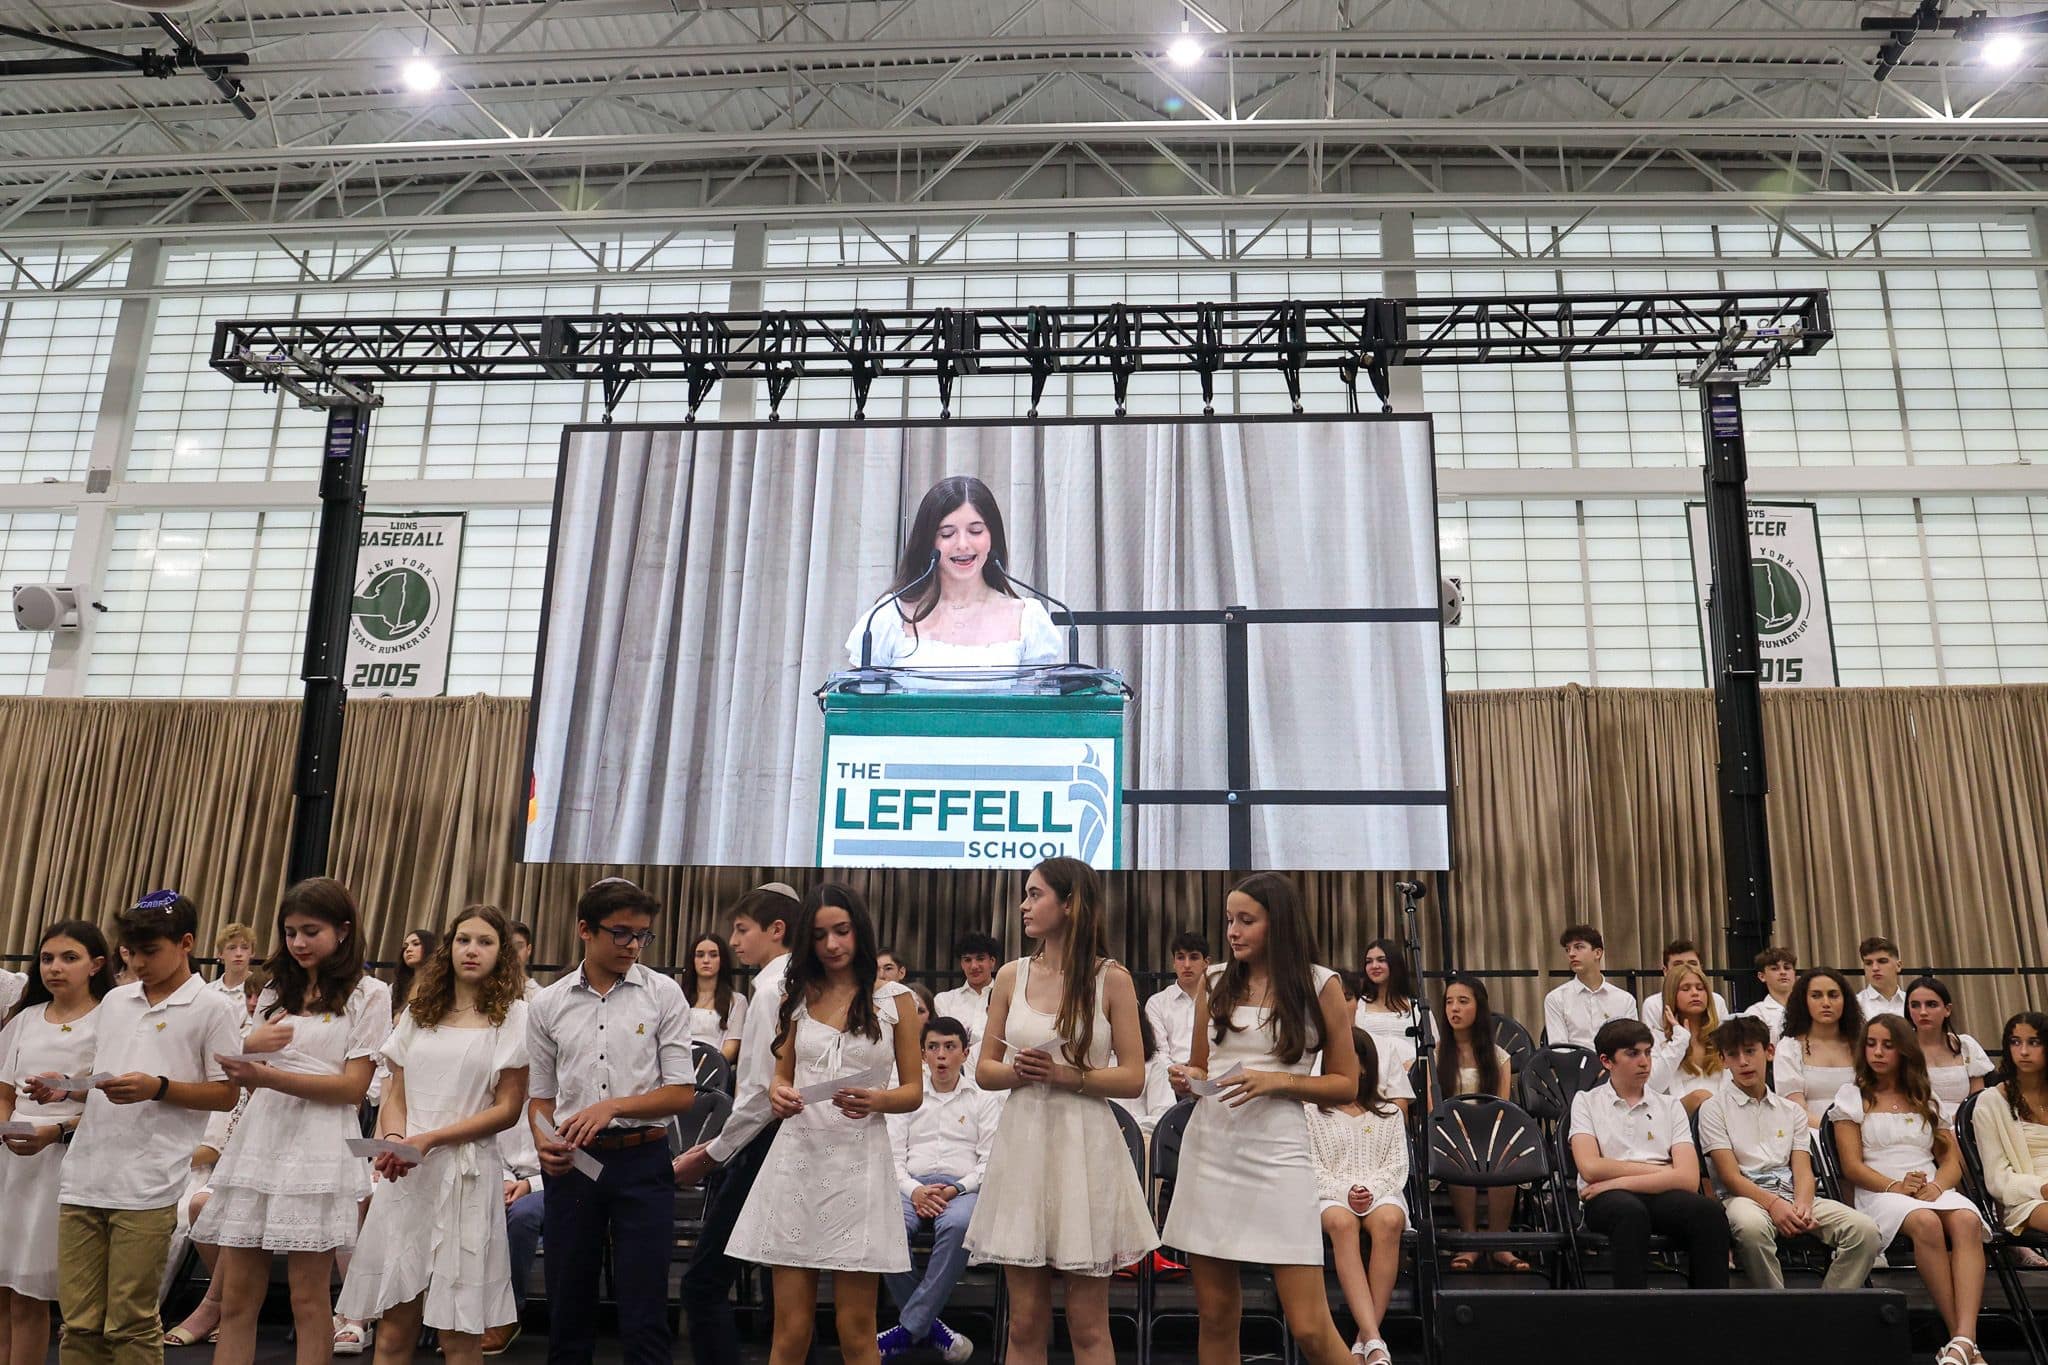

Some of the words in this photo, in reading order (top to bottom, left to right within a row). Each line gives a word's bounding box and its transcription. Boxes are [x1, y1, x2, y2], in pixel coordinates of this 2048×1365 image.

[390, 522, 418, 530] LIONS
[360, 531, 444, 547] BASEBALL
[367, 559, 394, 577] NEW
[402, 557, 432, 576] YORK
[1760, 547, 1794, 568] YORK
[351, 628, 377, 651] STATE
[378, 637, 420, 654] RUNNER
[419, 625, 432, 640] UP
[1759, 630, 1801, 649] RUNNER
[1798, 620, 1809, 634] UP
[351, 663, 421, 687] 2005
[837, 762, 881, 779] THE
[835, 788, 1073, 833] LEFFELL
